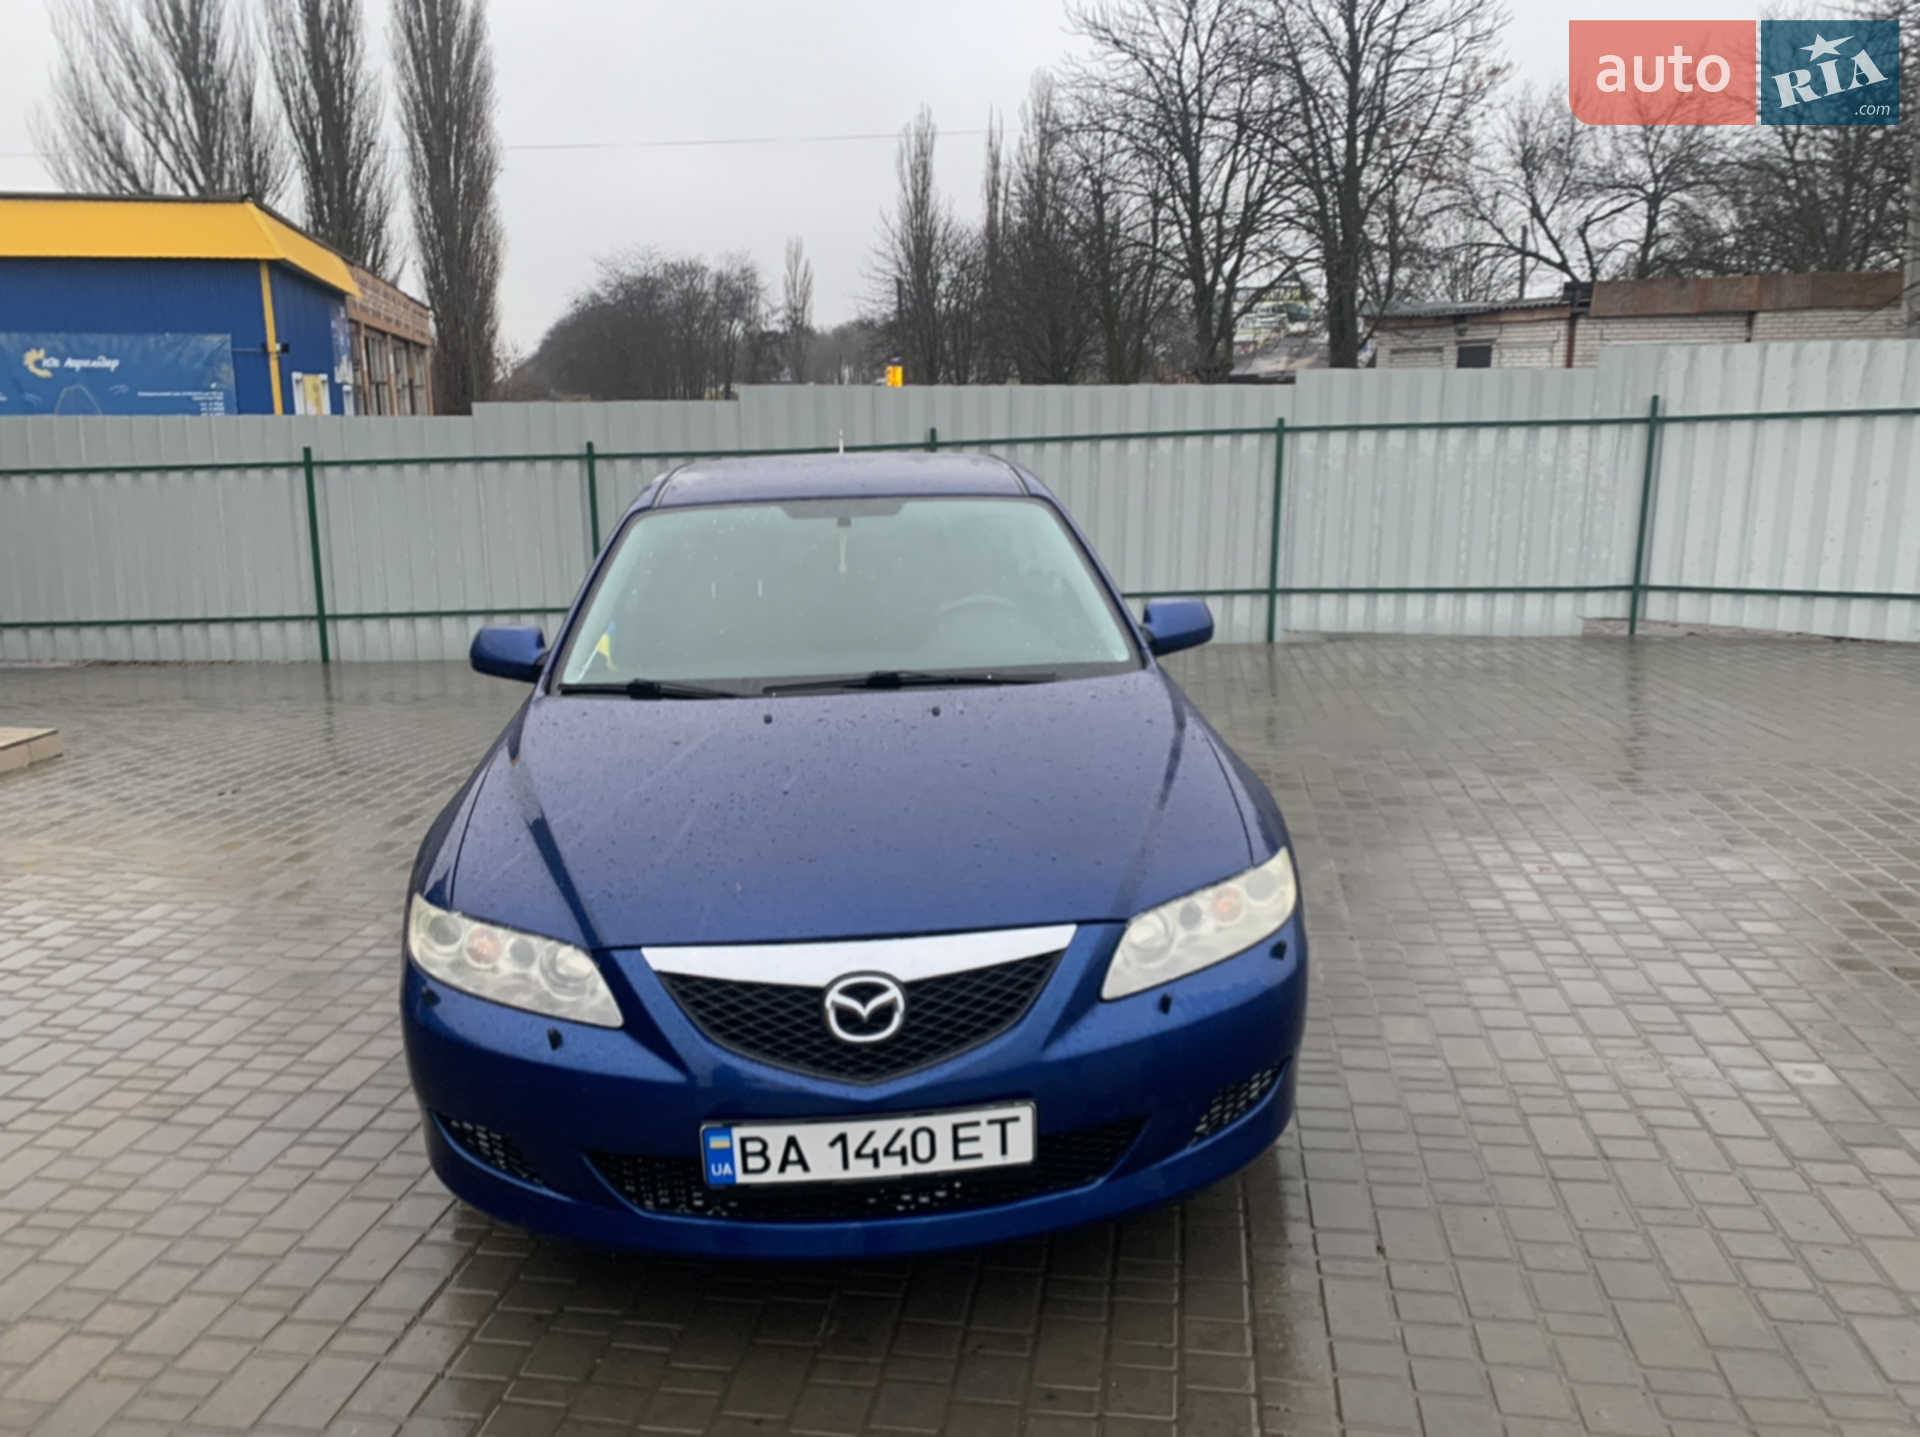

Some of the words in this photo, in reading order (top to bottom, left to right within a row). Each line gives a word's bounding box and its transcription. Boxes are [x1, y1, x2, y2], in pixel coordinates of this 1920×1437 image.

[738, 1135, 811, 1176] BA
[828, 1126, 937, 1172] 1440
[951, 1115, 1021, 1162] ET
[711, 1163, 734, 1177] UA
